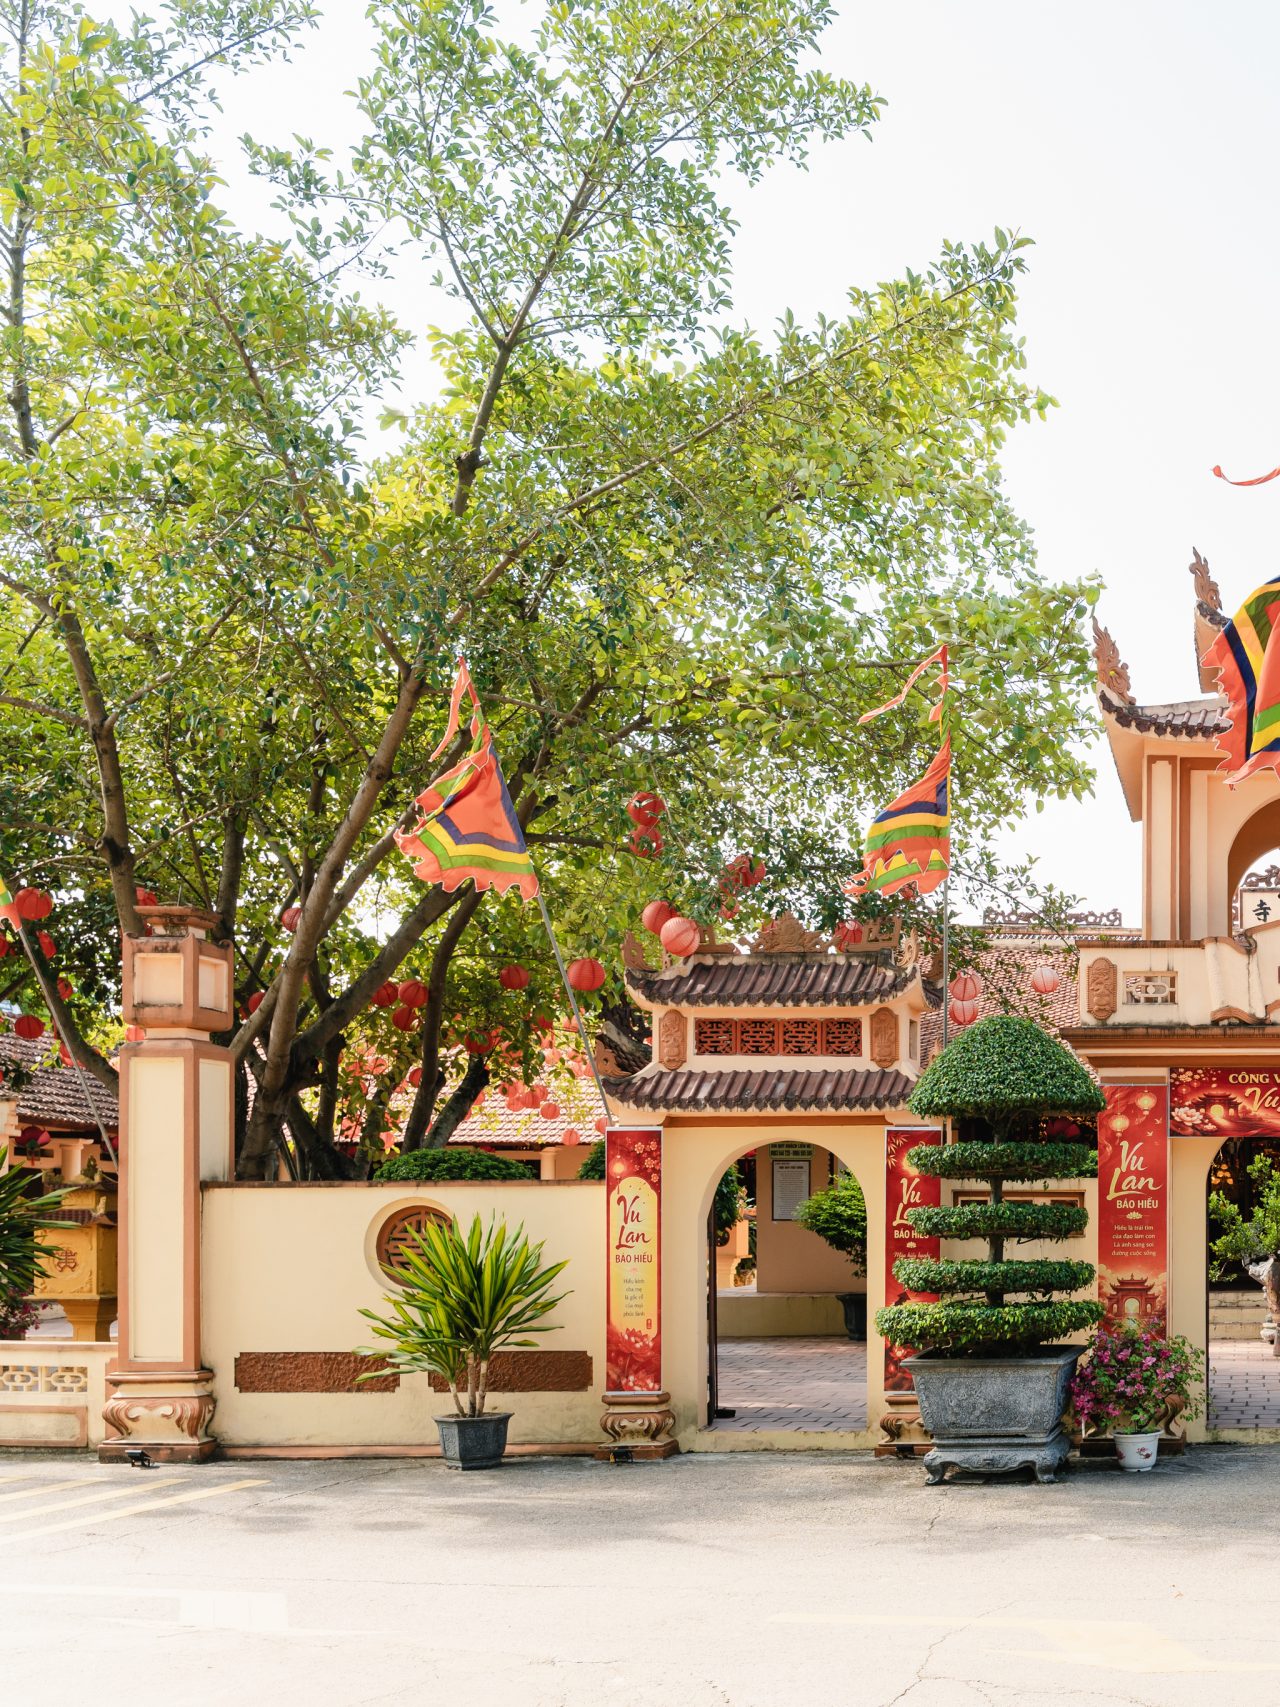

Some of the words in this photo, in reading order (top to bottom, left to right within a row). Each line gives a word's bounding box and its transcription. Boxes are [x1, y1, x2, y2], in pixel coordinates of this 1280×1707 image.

[1228, 1071, 1270, 1084] CÔNG
[1244, 1086, 1279, 1113] Vu
[1119, 1140, 1148, 1173] Vu
[900, 1177, 922, 1205] Vu
[1106, 1167, 1163, 1201] Lan
[616, 1195, 645, 1225] Vu
[1116, 1197, 1135, 1209] BÁO
[1137, 1196, 1159, 1209] HIẾU
[615, 1225, 651, 1250] Lan
[893, 1228, 910, 1239] BÁO
[615, 1252, 632, 1264] BÁO
[633, 1251, 653, 1263] HIẾU
